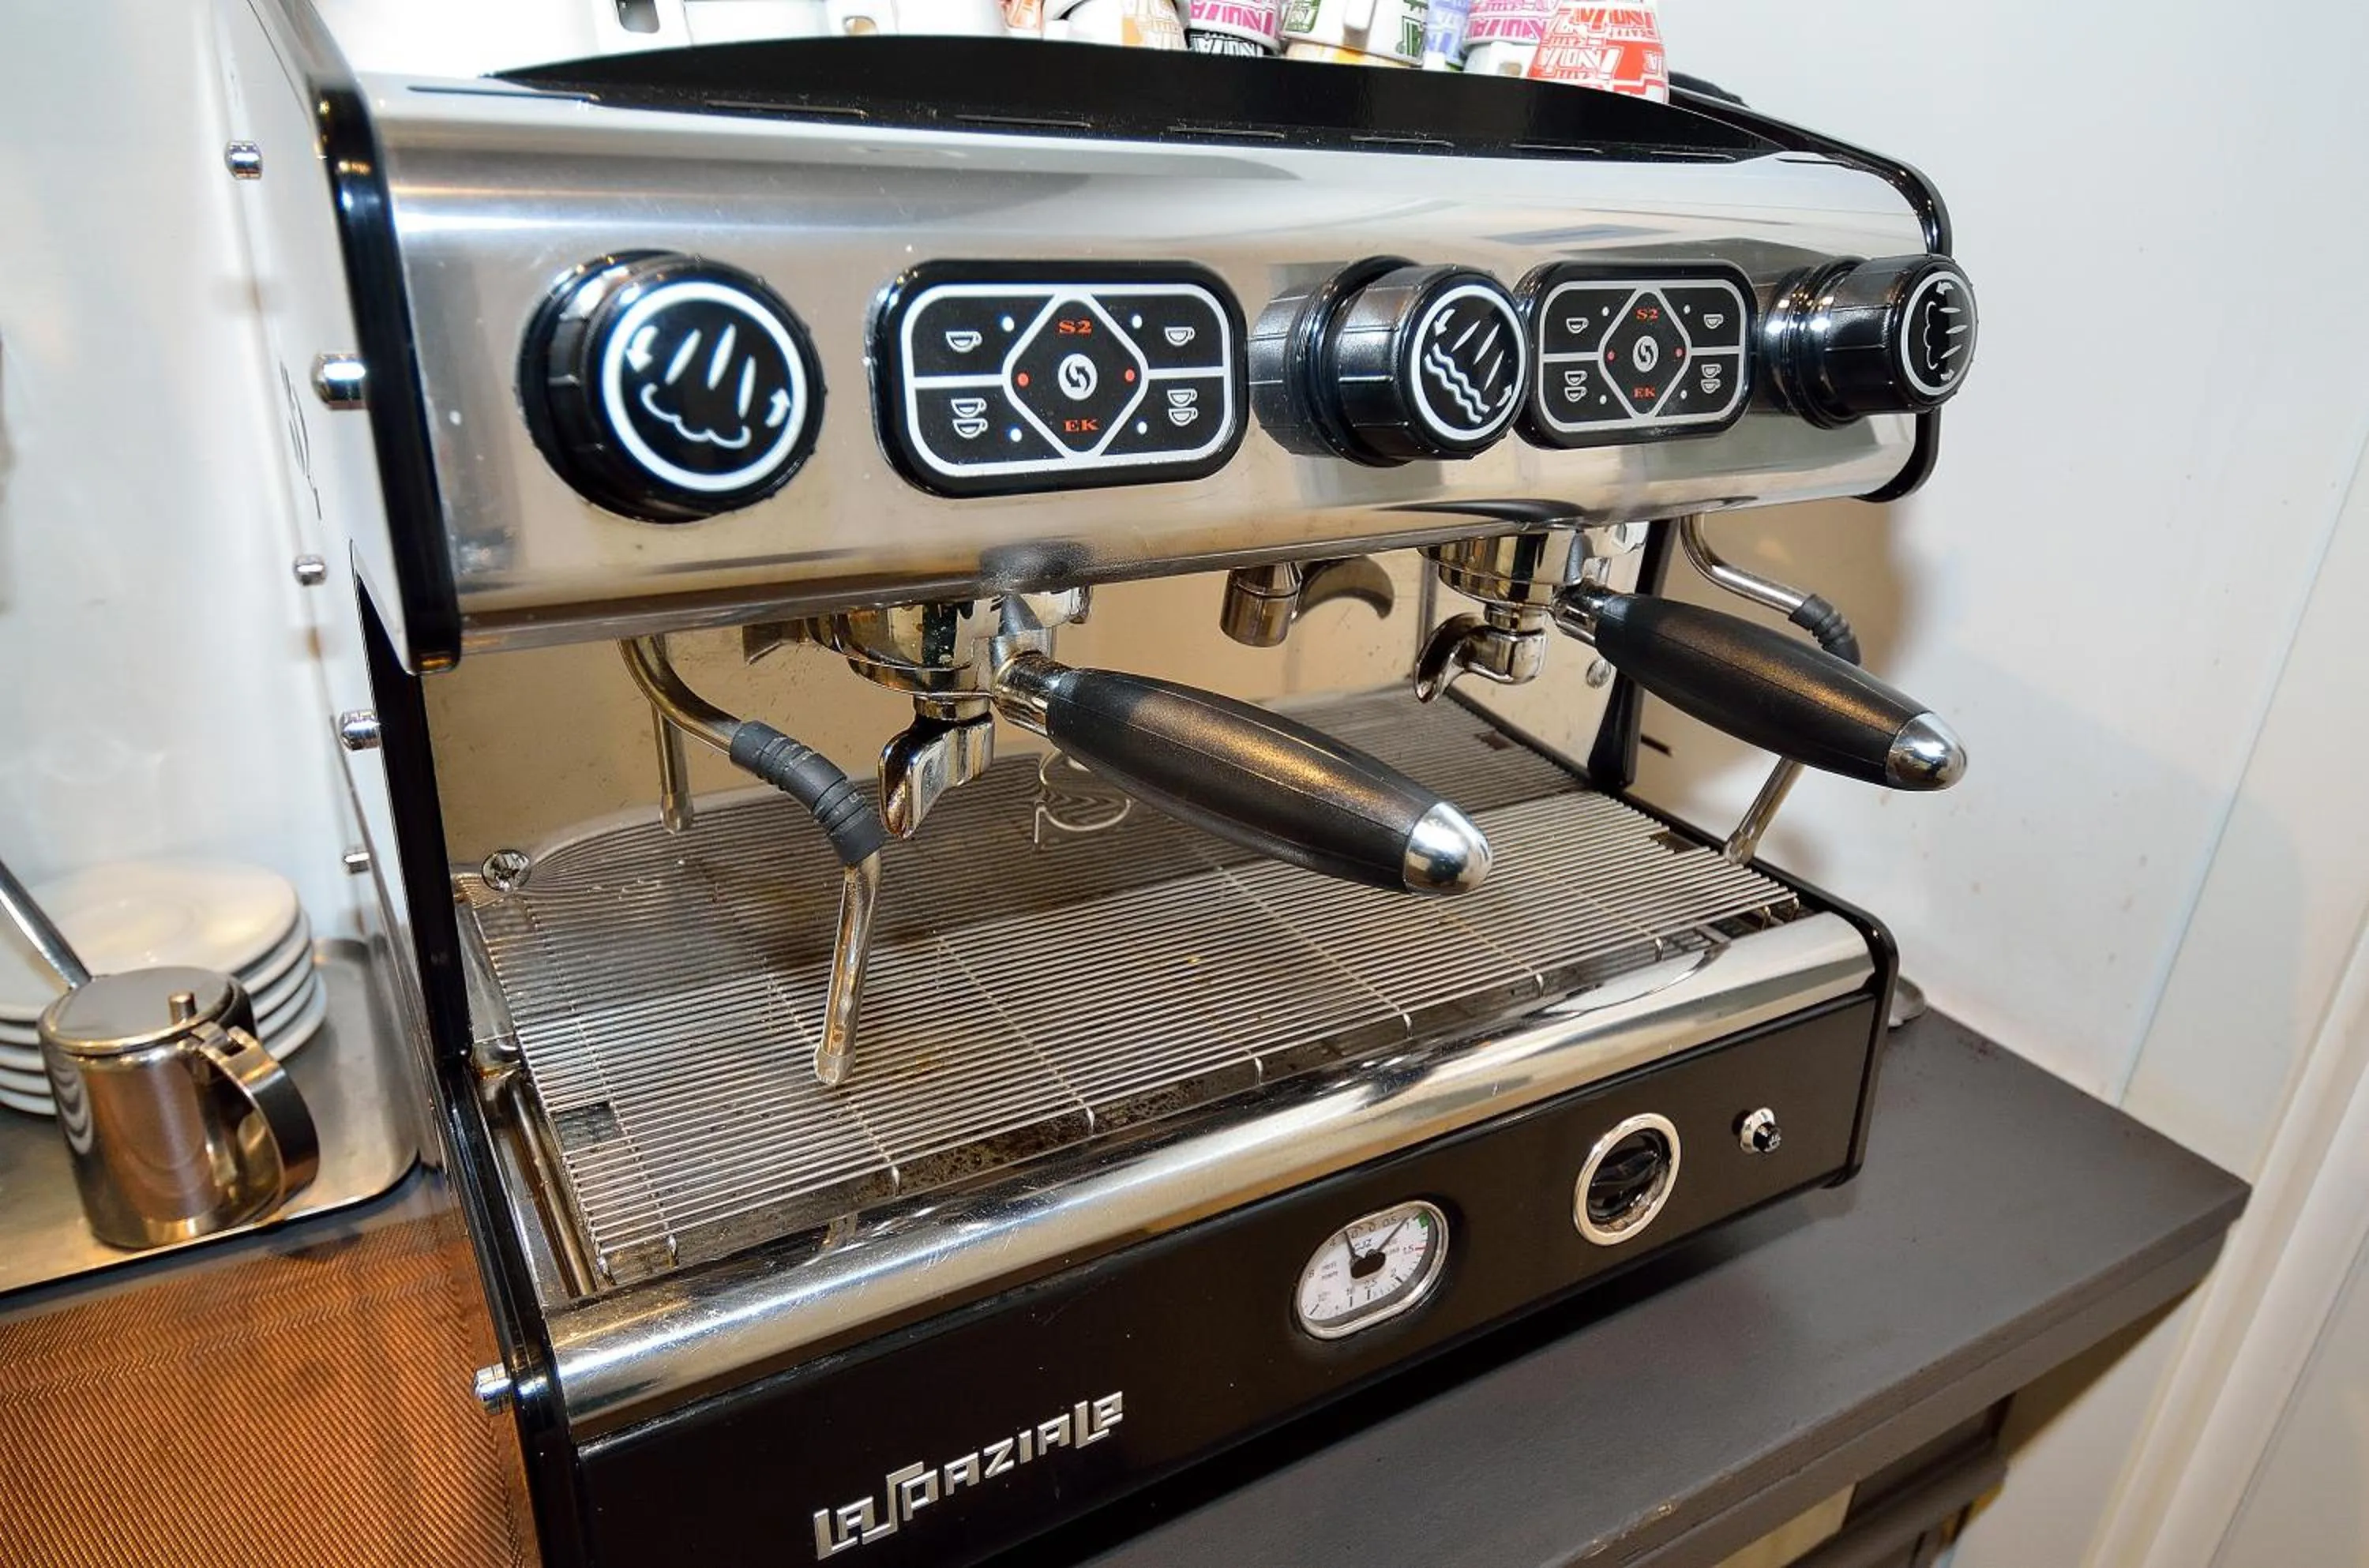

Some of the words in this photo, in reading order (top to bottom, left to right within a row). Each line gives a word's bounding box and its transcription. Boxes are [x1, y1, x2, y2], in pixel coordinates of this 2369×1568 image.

[1635, 307, 1659, 320] S2
[1058, 319, 1092, 335] S2
[1632, 387, 1656, 399] EK
[1064, 418, 1100, 433] EK
